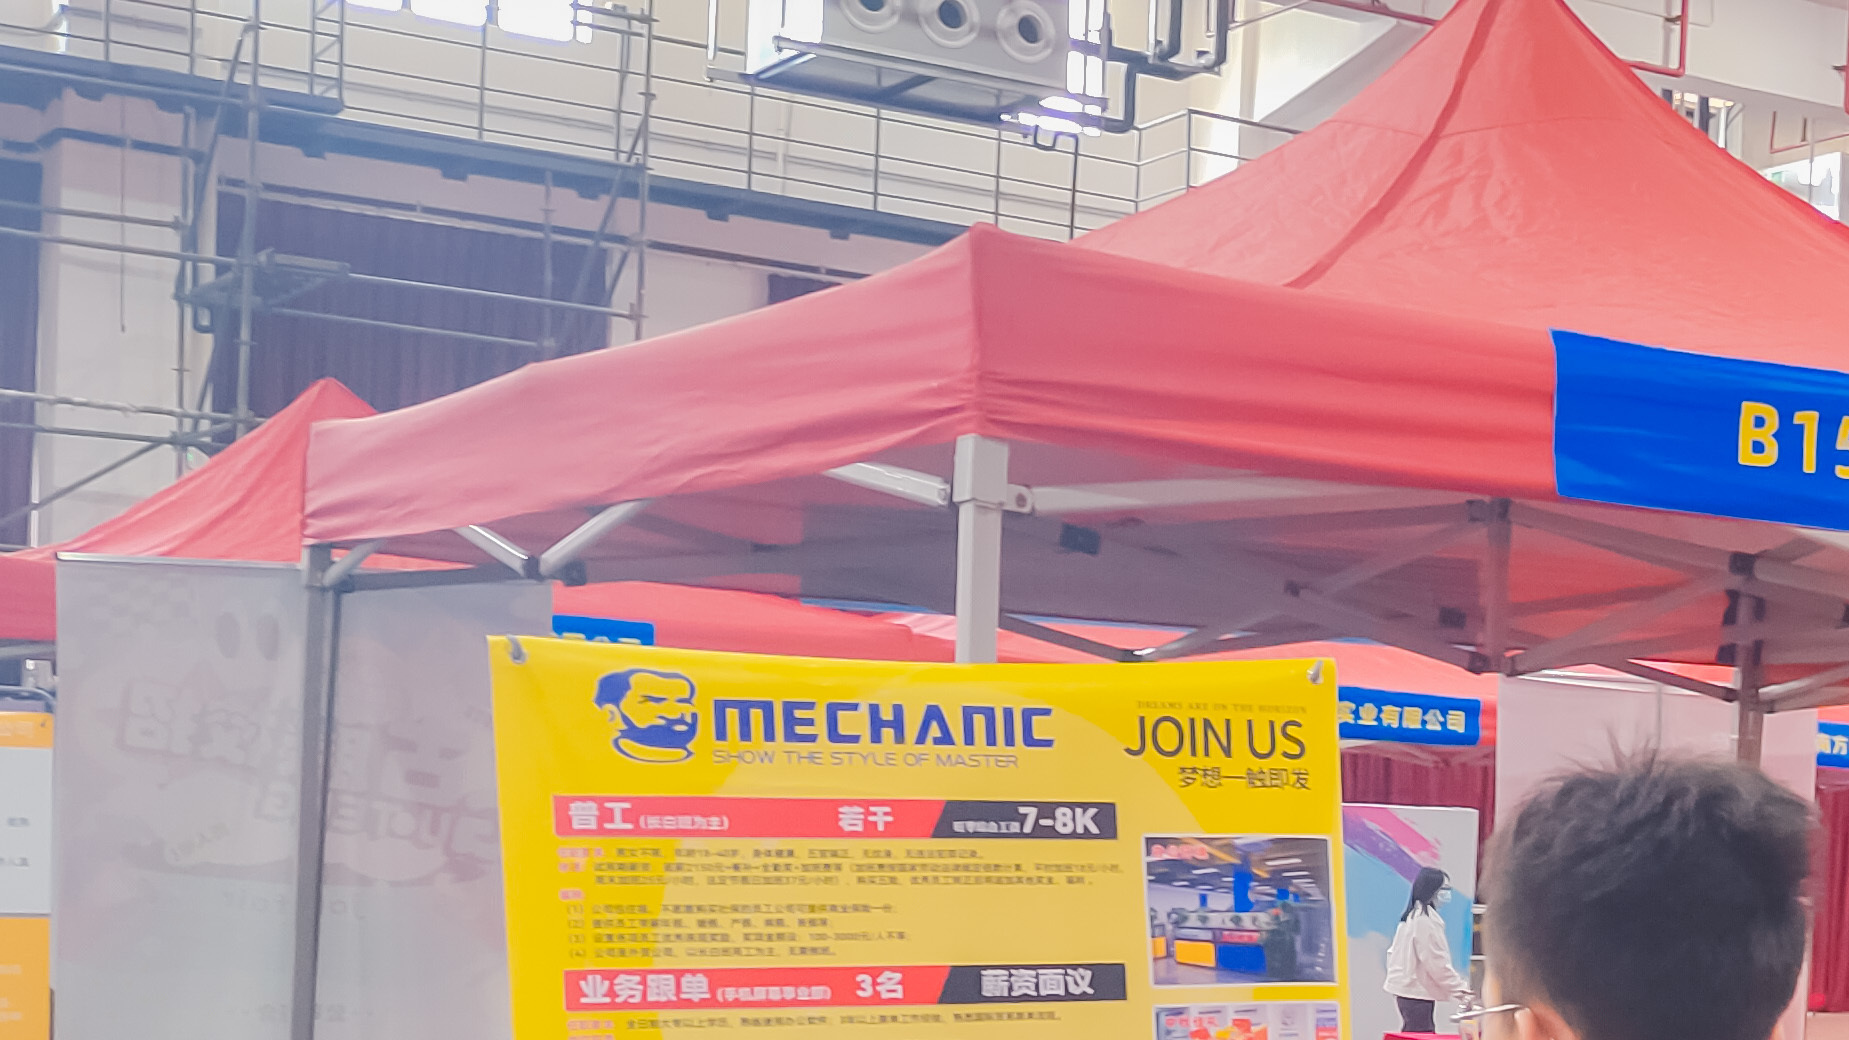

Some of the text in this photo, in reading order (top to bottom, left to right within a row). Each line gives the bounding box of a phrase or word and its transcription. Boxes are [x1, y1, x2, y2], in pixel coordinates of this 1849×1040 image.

[712, 698, 1056, 749] MECHANIC
[1124, 715, 1307, 760] JOIN US
[713, 749, 1019, 769] SHOW THE STYLE OF MASTER
[1178, 765, 1312, 791] 梦想一触即发
[568, 800, 634, 831] 普工
[838, 805, 895, 831] 若干
[579, 973, 711, 1004] 业务跟单
[855, 970, 904, 1000] 3名
[979, 966, 1095, 997] 薪资面议
